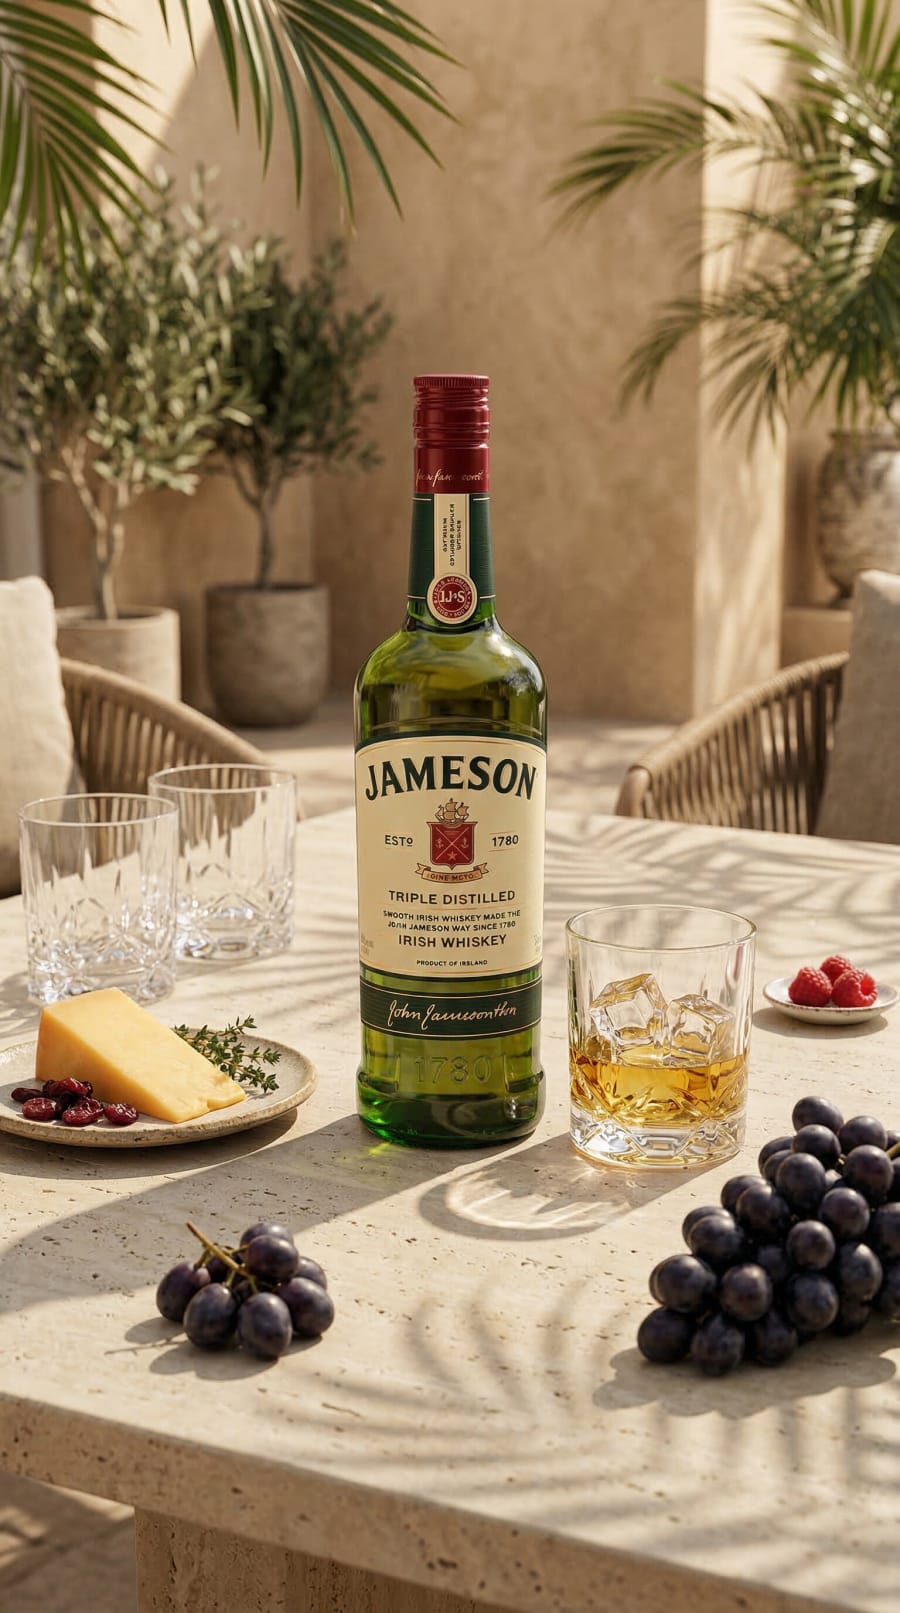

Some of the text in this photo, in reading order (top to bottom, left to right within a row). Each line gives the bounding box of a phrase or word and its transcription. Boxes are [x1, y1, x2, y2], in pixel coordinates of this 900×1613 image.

[365, 755, 537, 801] JAMESON
[492, 834, 519, 848] 1780
[388, 890, 516, 905] TRIPLE DISTILLED
[416, 914, 439, 922] IRISH
[441, 914, 482, 922] WHISKEY
[483, 911, 506, 921] MADE
[507, 909, 521, 918] THE
[409, 923, 450, 932] JAMESON
[451, 924, 471, 932] WAY
[473, 922, 498, 931] SINCE
[398, 933, 507, 948] IRISH WHISKEY
[416, 959, 447, 967] PRODUCT
[387, 999, 421, 1027] John
[414, 1055, 493, 1084] 1780
